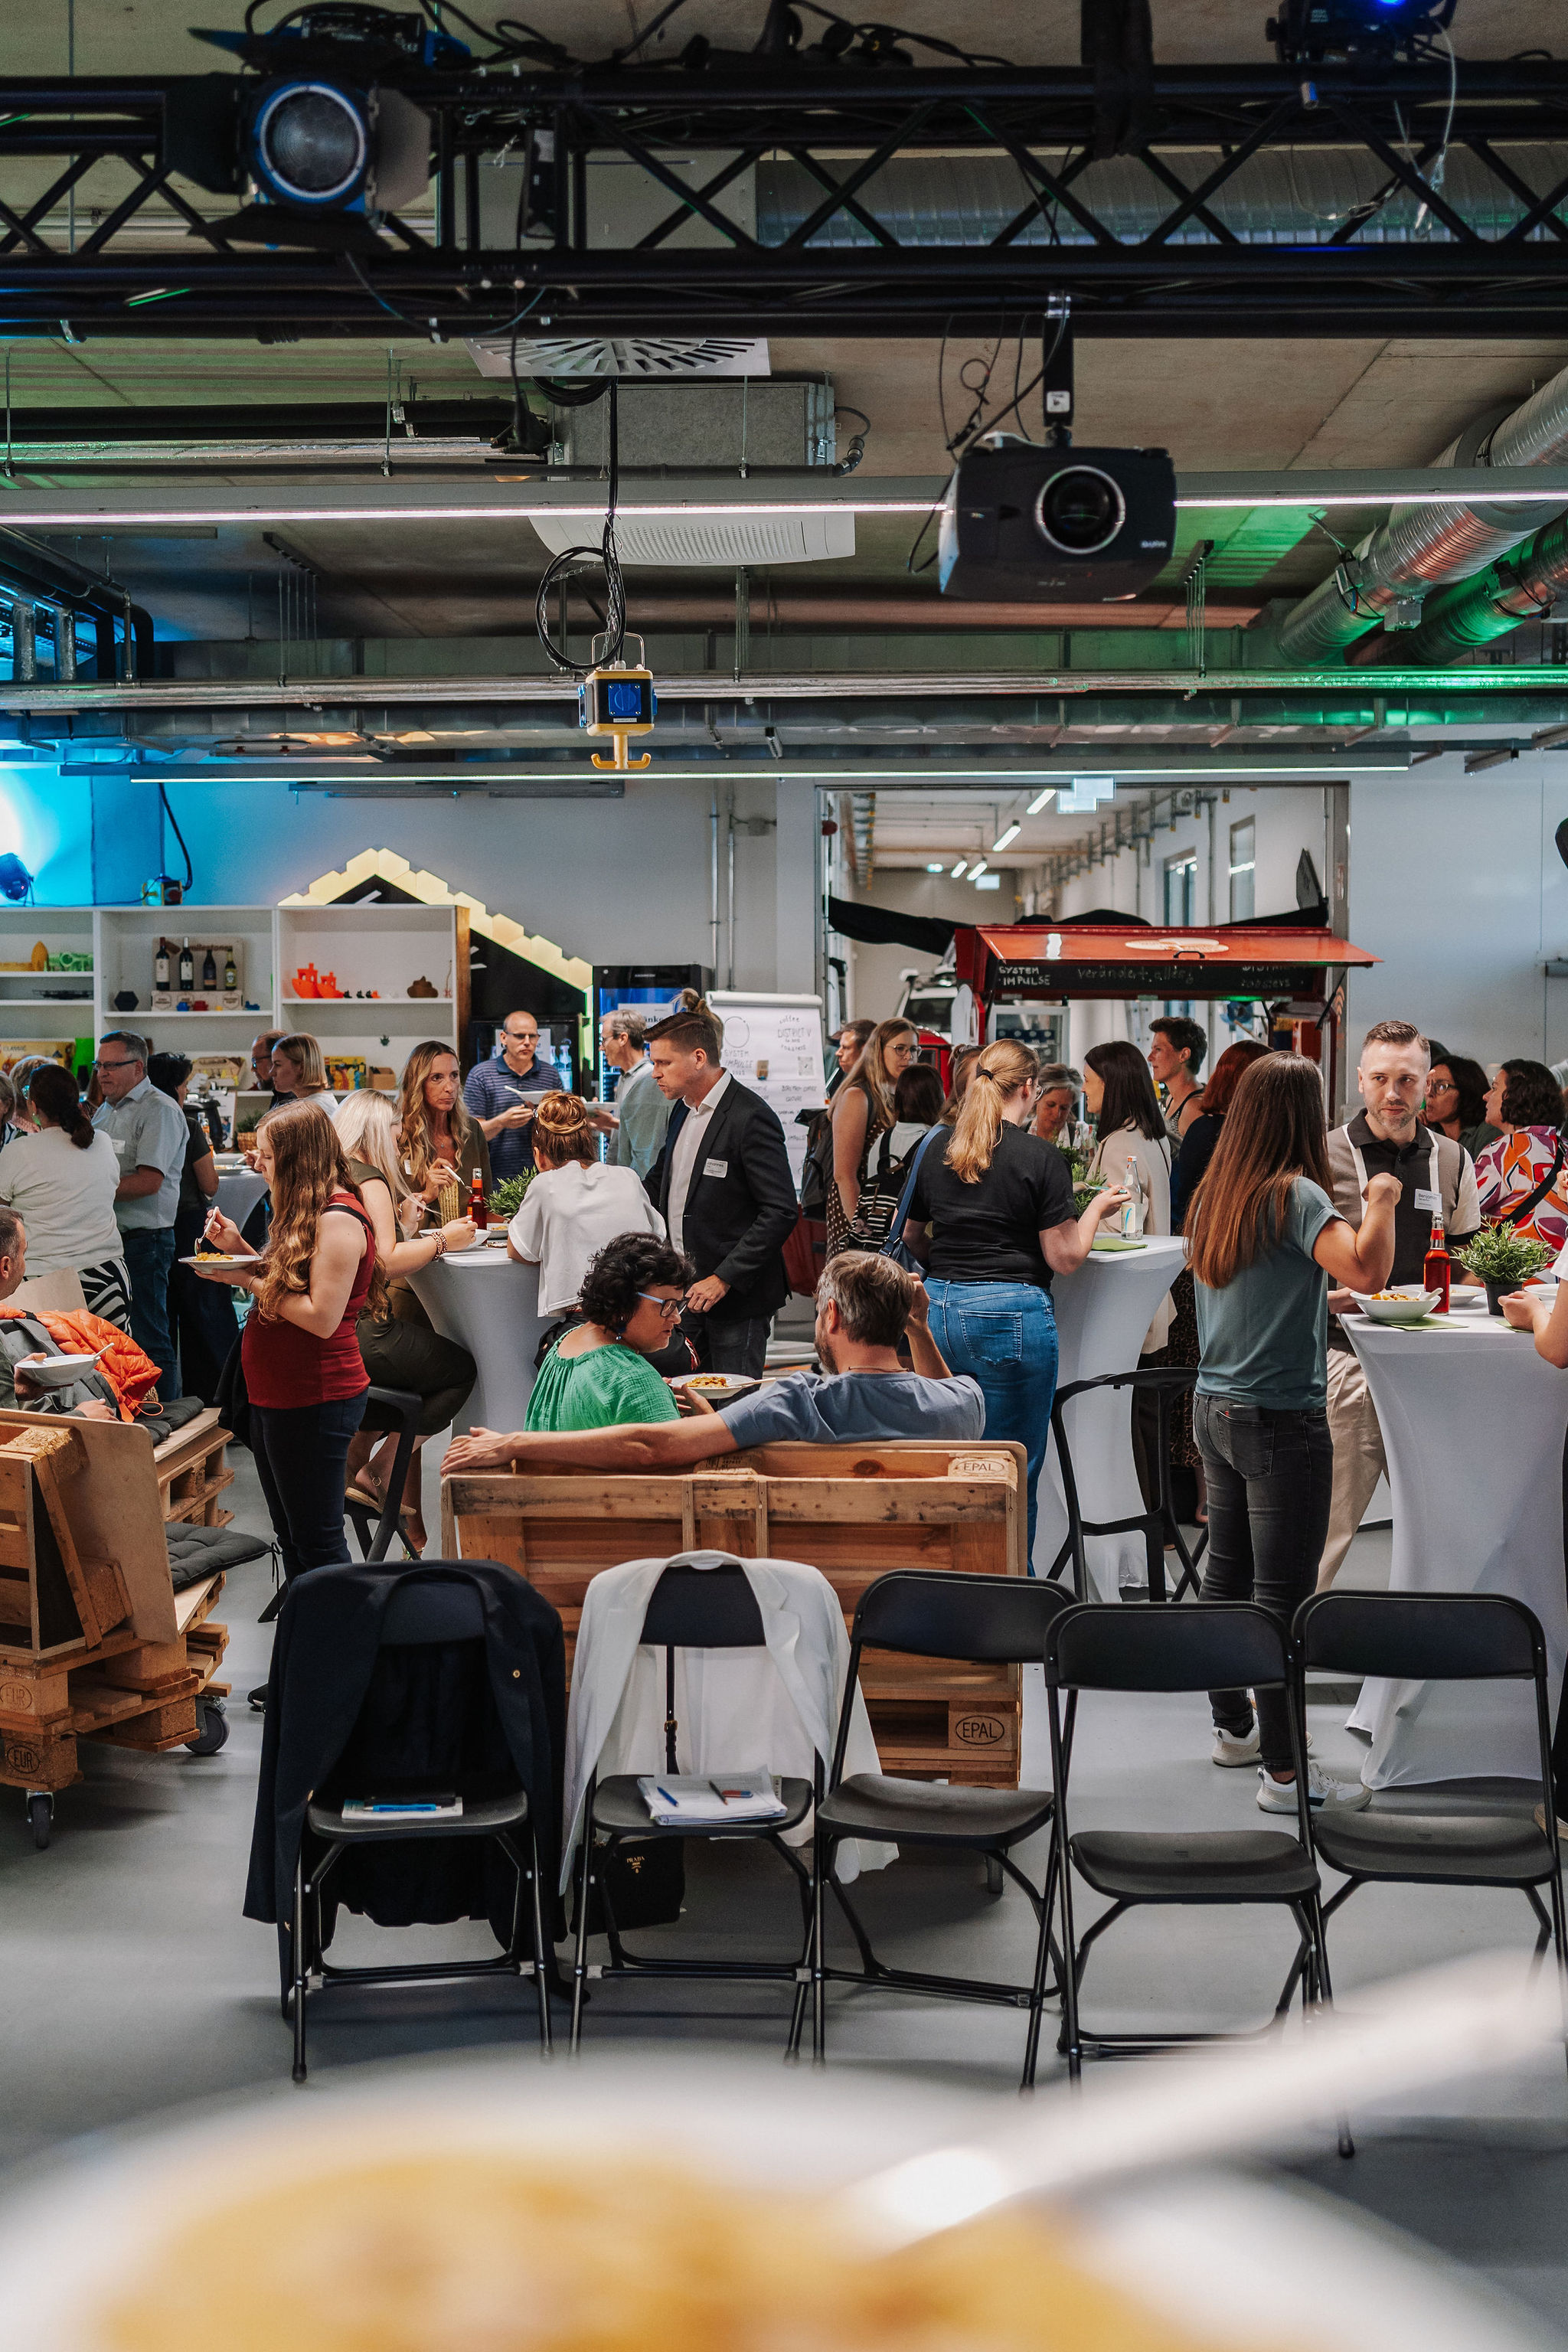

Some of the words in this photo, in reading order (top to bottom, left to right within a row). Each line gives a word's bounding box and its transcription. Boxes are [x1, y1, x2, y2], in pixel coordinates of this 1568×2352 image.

[998, 966, 1040, 975] SYSTEM
[1003, 975, 1051, 986] IMPULSE
[963, 1462, 994, 1472] EPAL
[962, 1722, 998, 1739] EPAL
[14, 1749, 34, 1770] EUR
